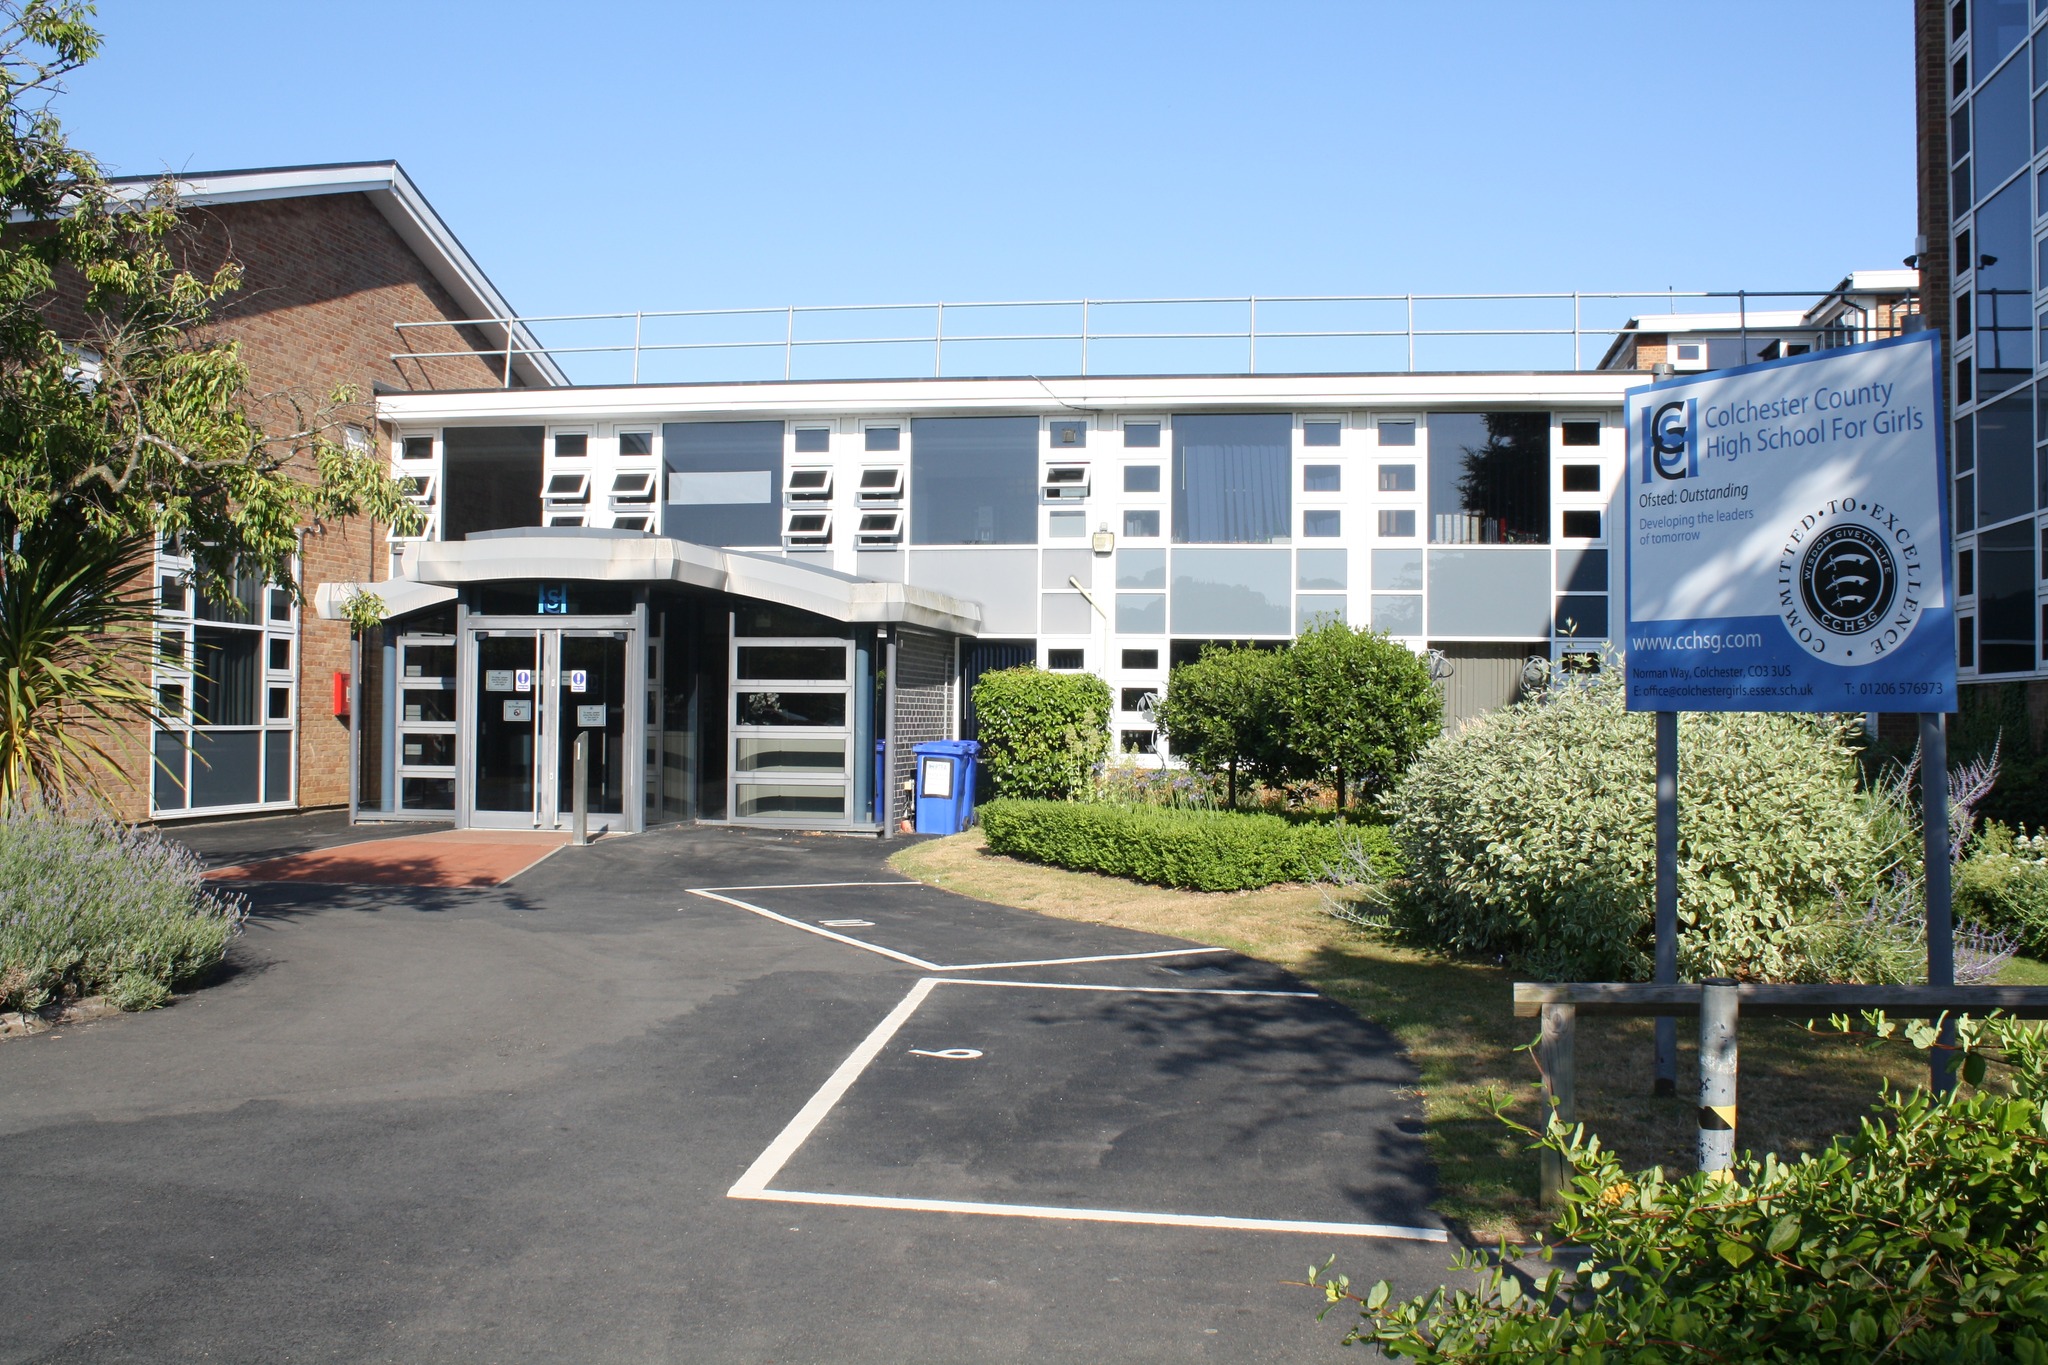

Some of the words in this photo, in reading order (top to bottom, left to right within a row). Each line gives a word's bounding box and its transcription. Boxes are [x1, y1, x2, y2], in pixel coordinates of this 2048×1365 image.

[1705, 396, 1809, 429] Colchester
[1814, 382, 1893, 411] County
[1707, 432, 1751, 461] High
[1757, 419, 1825, 452] School
[1833, 418, 1867, 441] For
[1873, 406, 1924, 434] Girls
[1639, 490, 1677, 508] Ofsted:
[1680, 484, 1748, 503] Outstanding
[1640, 514, 1694, 530] Developing
[1698, 512, 1714, 524] the
[1717, 508, 1754, 522] leaders
[1640, 532, 1650, 545] of
[1652, 532, 1700, 544] tomorrow
[1804, 536, 1831, 580] WISDOM
[1835, 529, 1875, 545] GIVETH
[1877, 548, 1892, 575] LIFE
[1779, 514, 1826, 653] COMMITTED
[1827, 498, 1855, 514] TO
[1870, 503, 1921, 655] EXCELLENCE
[1821, 611, 1878, 631] CCHSG
[1633, 630, 1761, 653] www.cchsg.com
[1633, 668, 1668, 679] Norman
[1670, 668, 1692, 680] Way,
[1694, 667, 1745, 678] Colchester,
[1748, 666, 1768, 677] CO3
[1772, 665, 1791, 677] 3US
[1634, 686, 1642, 697] E:
[1643, 684, 1813, 698] office@colchestergirls.essex.sch.uk
[1844, 683, 1854, 694] T:
[1860, 683, 1895, 695] 01206
[1899, 682, 1943, 695] 576973
